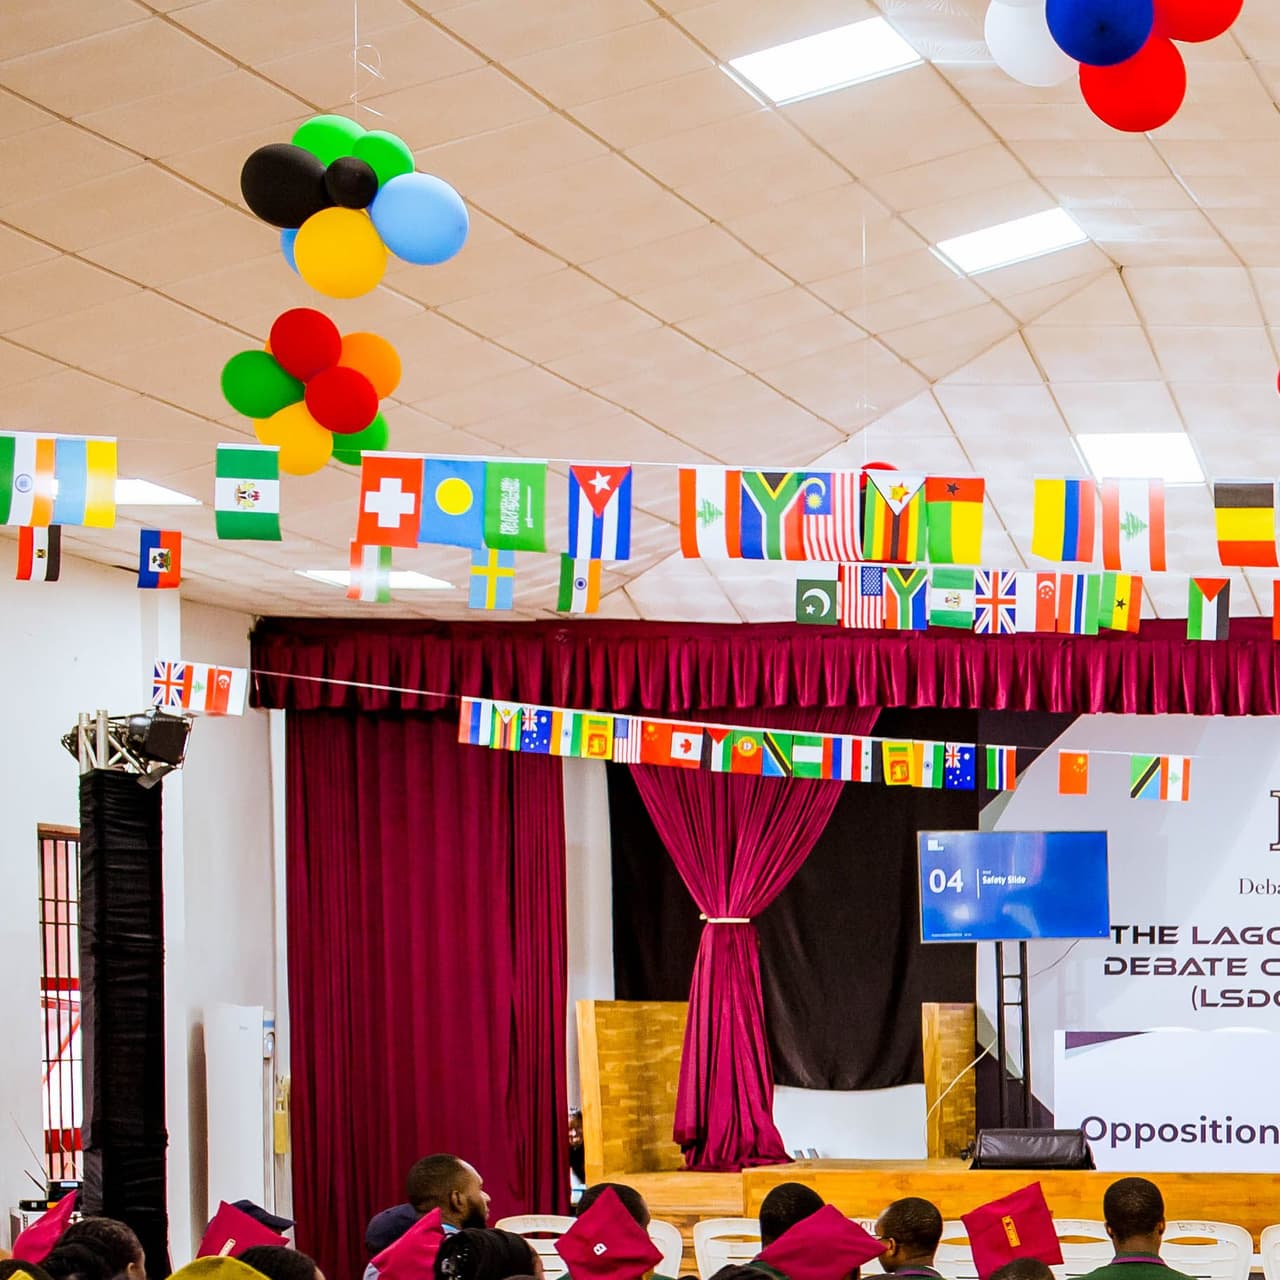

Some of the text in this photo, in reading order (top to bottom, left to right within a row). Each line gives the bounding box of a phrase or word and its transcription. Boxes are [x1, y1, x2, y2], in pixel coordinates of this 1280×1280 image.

[929, 868, 964, 894] 04
[982, 875, 1006, 887] Safety
[1110, 925, 1180, 945] THE
[1103, 956, 1248, 977] DEBATE
[1080, 1115, 1280, 1149] Opposition
